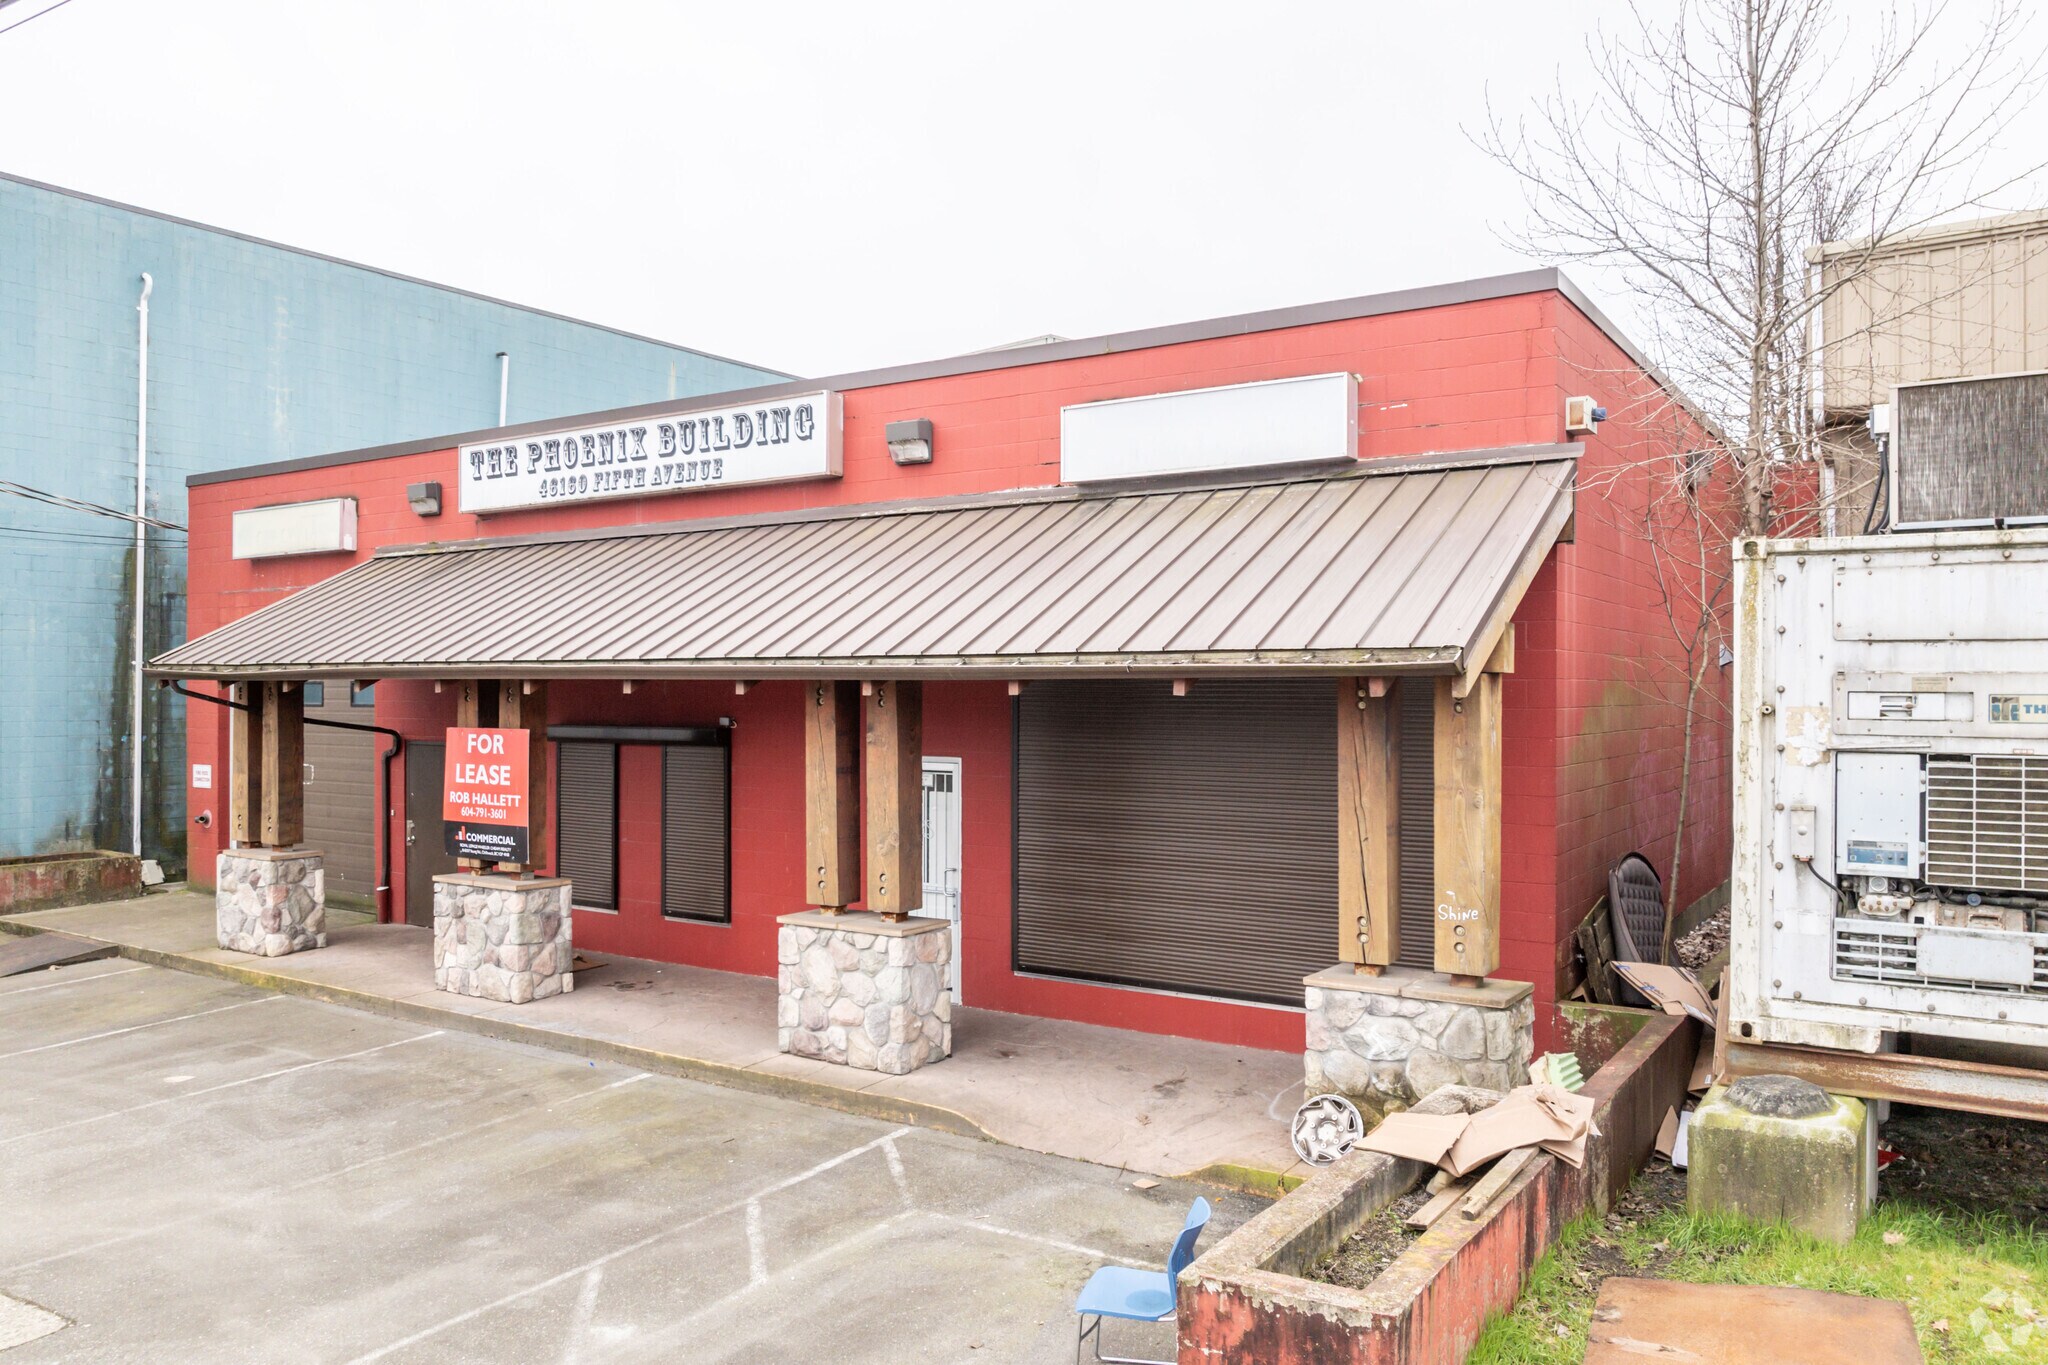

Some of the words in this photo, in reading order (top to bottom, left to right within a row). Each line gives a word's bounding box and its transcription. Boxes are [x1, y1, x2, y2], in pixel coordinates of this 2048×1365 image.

[470, 444, 518, 481] THE
[526, 426, 647, 473] PHOENIX
[656, 403, 815, 457] BUILDING
[592, 465, 646, 493] FIFTH
[650, 457, 723, 486] AVENUE
[2022, 704, 2048, 714] TH
[467, 733, 504, 754] FOR
[455, 763, 511, 786] LEASE
[449, 791, 470, 804] ROB
[472, 793, 521, 807] HALLETT
[461, 807, 507, 819] 604-791-3601
[466, 832, 516, 845] COMMERCIAL
